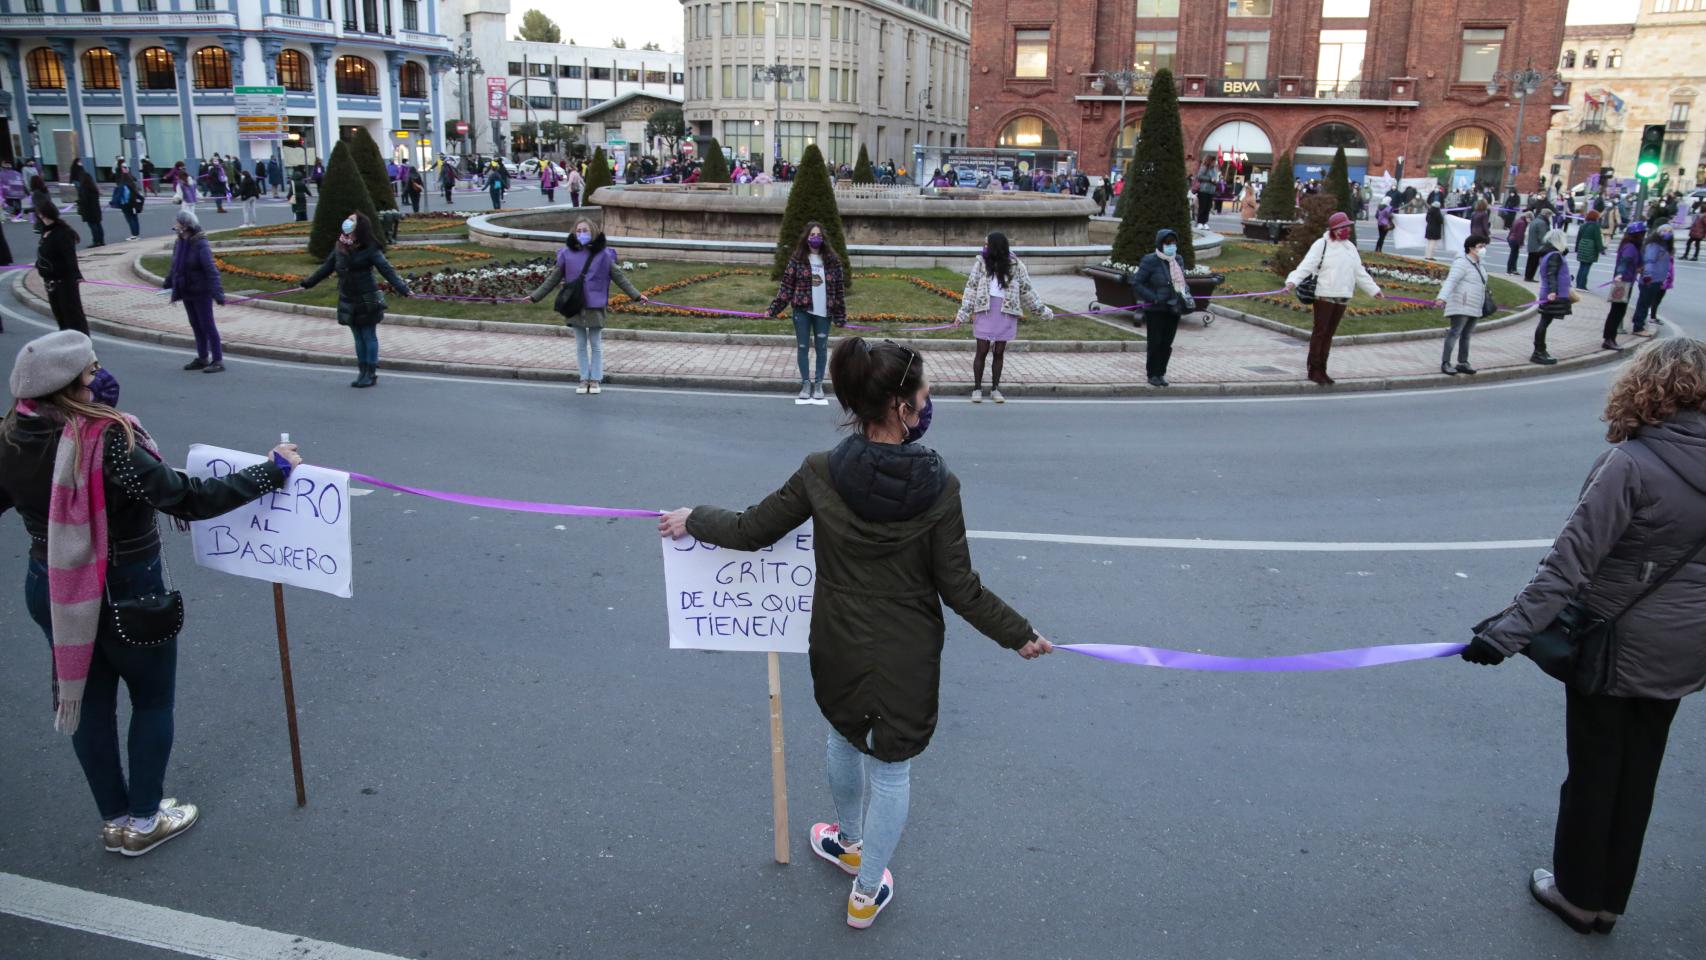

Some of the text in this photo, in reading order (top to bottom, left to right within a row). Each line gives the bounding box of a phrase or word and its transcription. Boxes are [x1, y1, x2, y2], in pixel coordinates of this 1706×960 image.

[1223, 80, 1261, 93] BBVA
[692, 110, 805, 120] MUSEO DE LON
[250, 514, 280, 533] AL
[206, 525, 337, 575] BASURERO
[680, 591, 813, 613] DE LAS QUE
